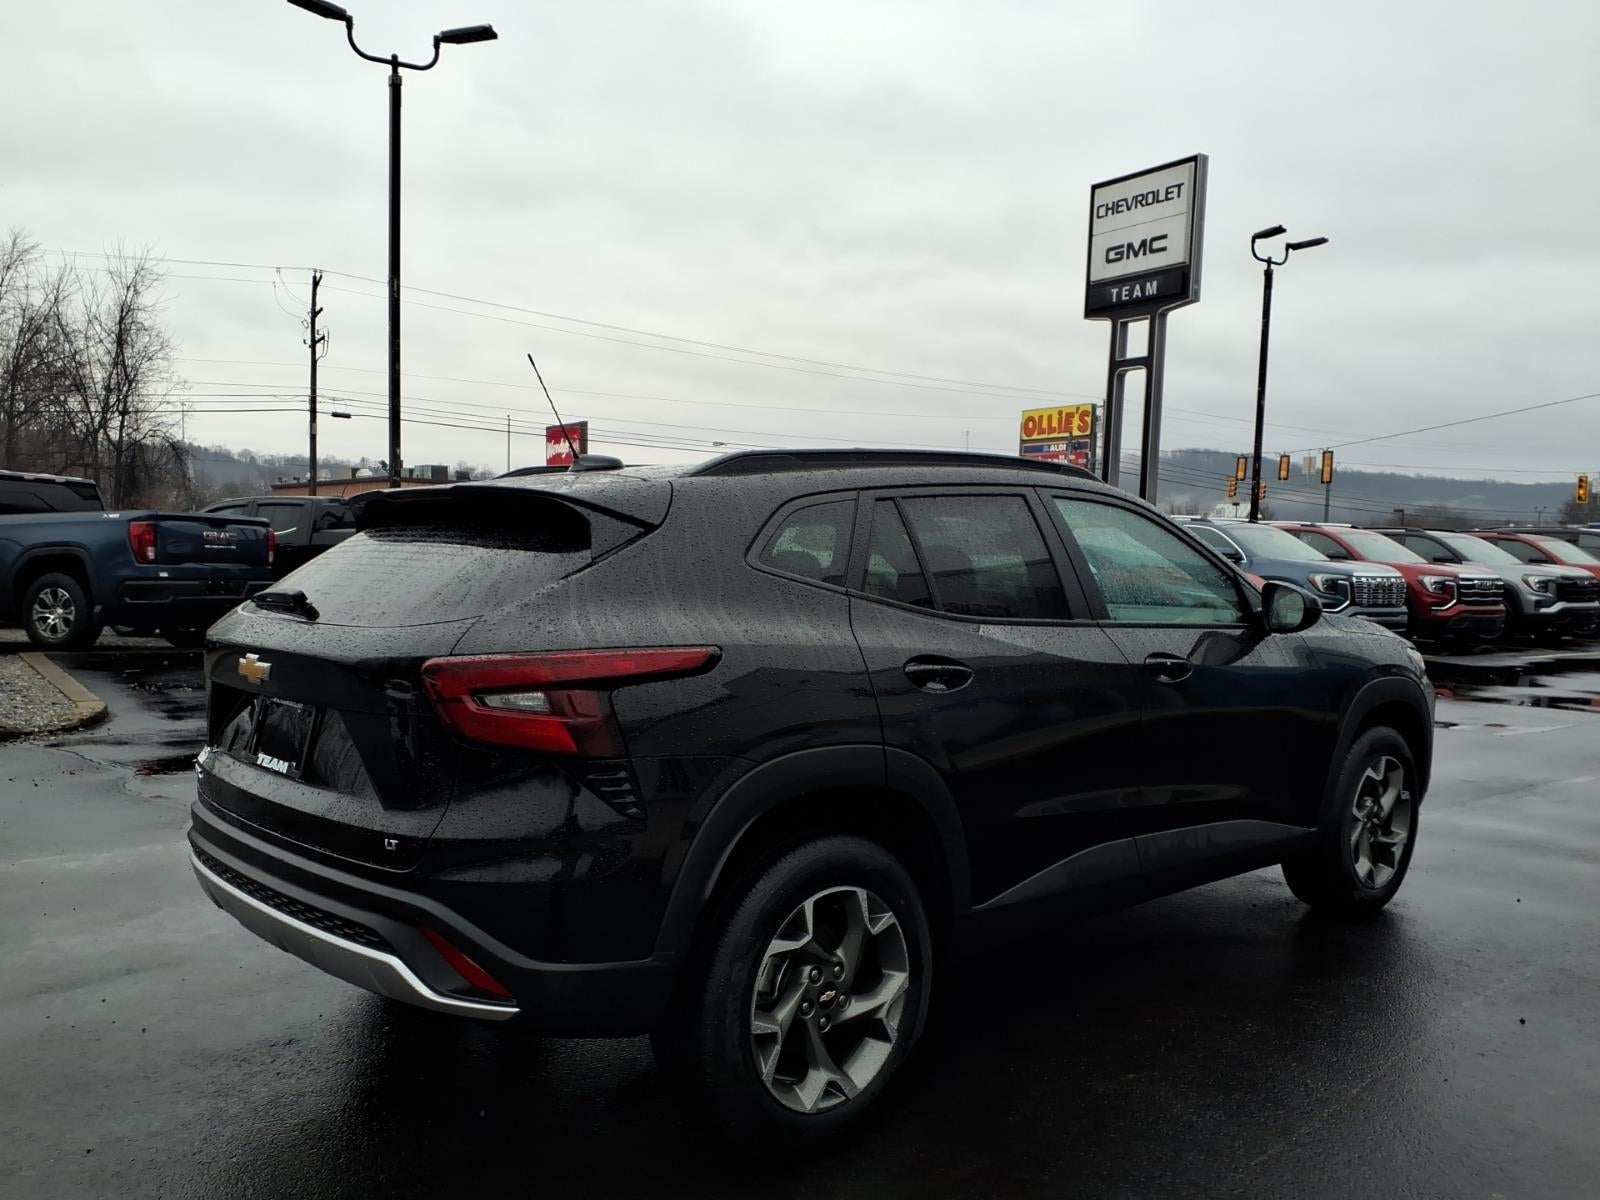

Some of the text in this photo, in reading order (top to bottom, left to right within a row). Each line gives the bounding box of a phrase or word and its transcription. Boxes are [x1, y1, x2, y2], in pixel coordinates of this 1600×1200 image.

[1096, 182, 1184, 219] CHEVROLET
[1105, 234, 1168, 264] GMC
[1111, 281, 1158, 302] TEAM
[1023, 407, 1091, 438] OLLIE'S
[1049, 443, 1067, 452] ALDI
[256, 752, 289, 774] TEAM
[384, 838, 399, 851] LT
